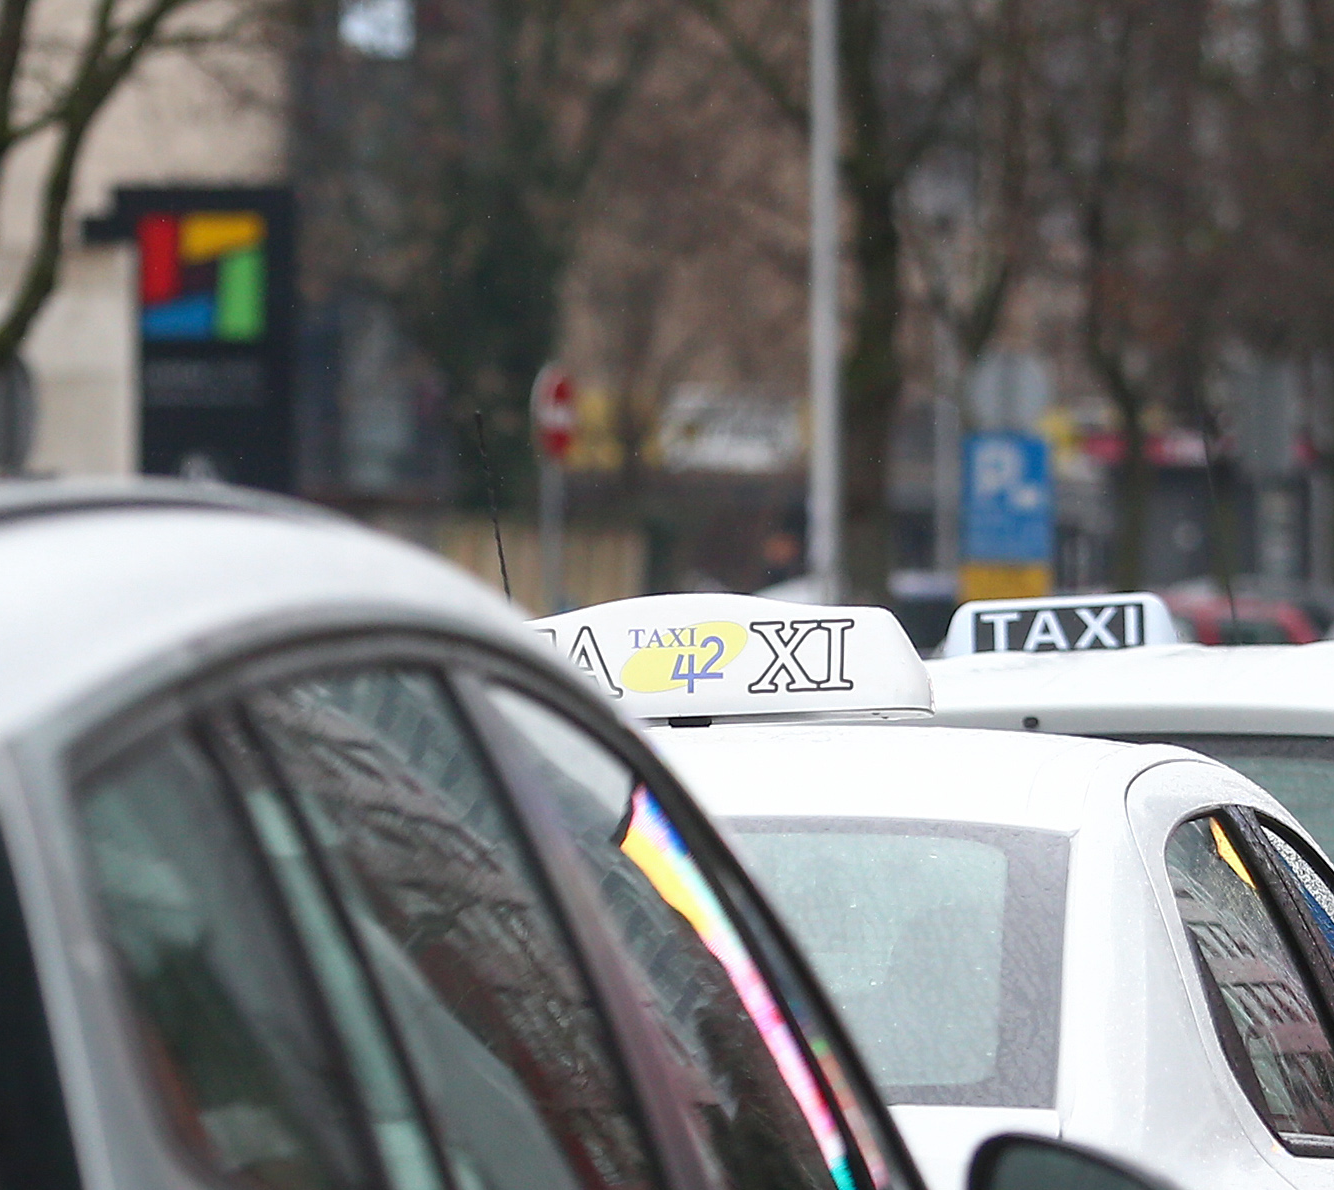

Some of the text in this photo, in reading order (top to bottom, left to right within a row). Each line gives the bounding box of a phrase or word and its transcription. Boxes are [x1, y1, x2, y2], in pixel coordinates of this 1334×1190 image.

[628, 627, 698, 649] TAXI
[979, 605, 1141, 651] TAXI
[534, 626, 624, 699] A
[670, 636, 724, 694] 42
